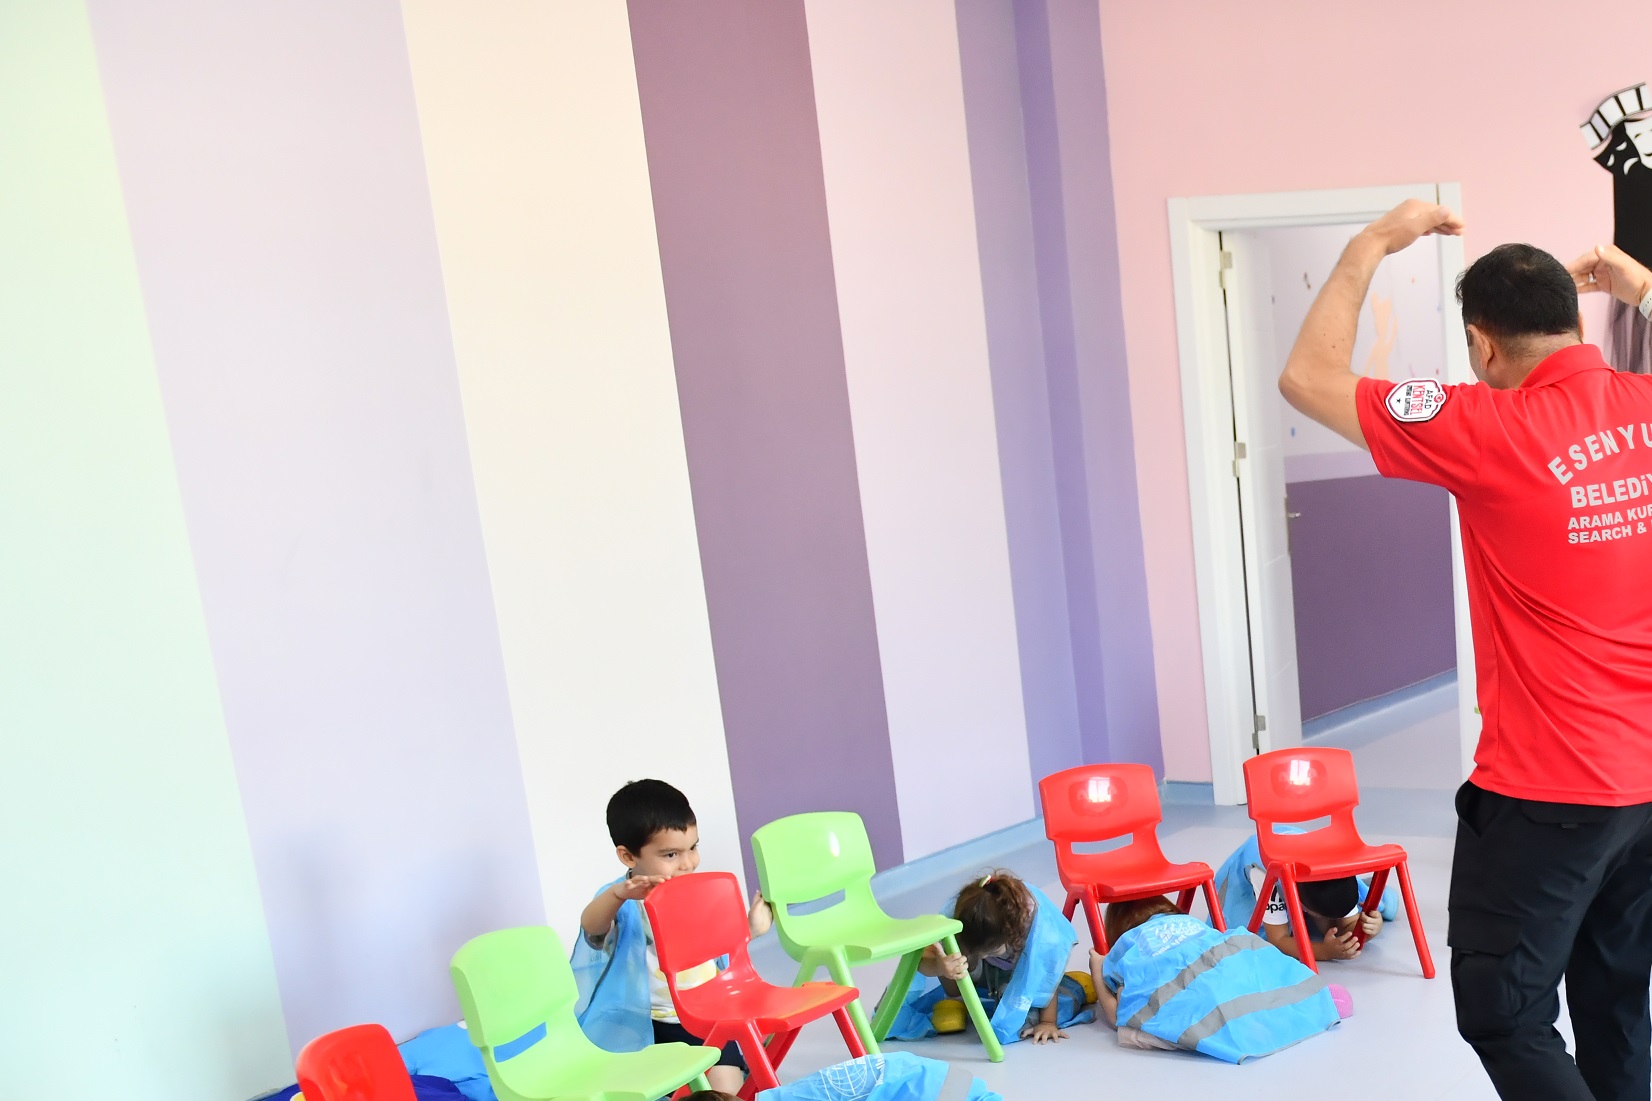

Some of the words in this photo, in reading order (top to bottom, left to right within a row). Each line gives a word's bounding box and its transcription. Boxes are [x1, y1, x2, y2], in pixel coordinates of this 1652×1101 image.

[1424, 389, 1434, 410] AFAD
[1567, 511, 1624, 530] ARAMA
[1567, 524, 1633, 544] SEARCH
[1636, 521, 1647, 534] &
